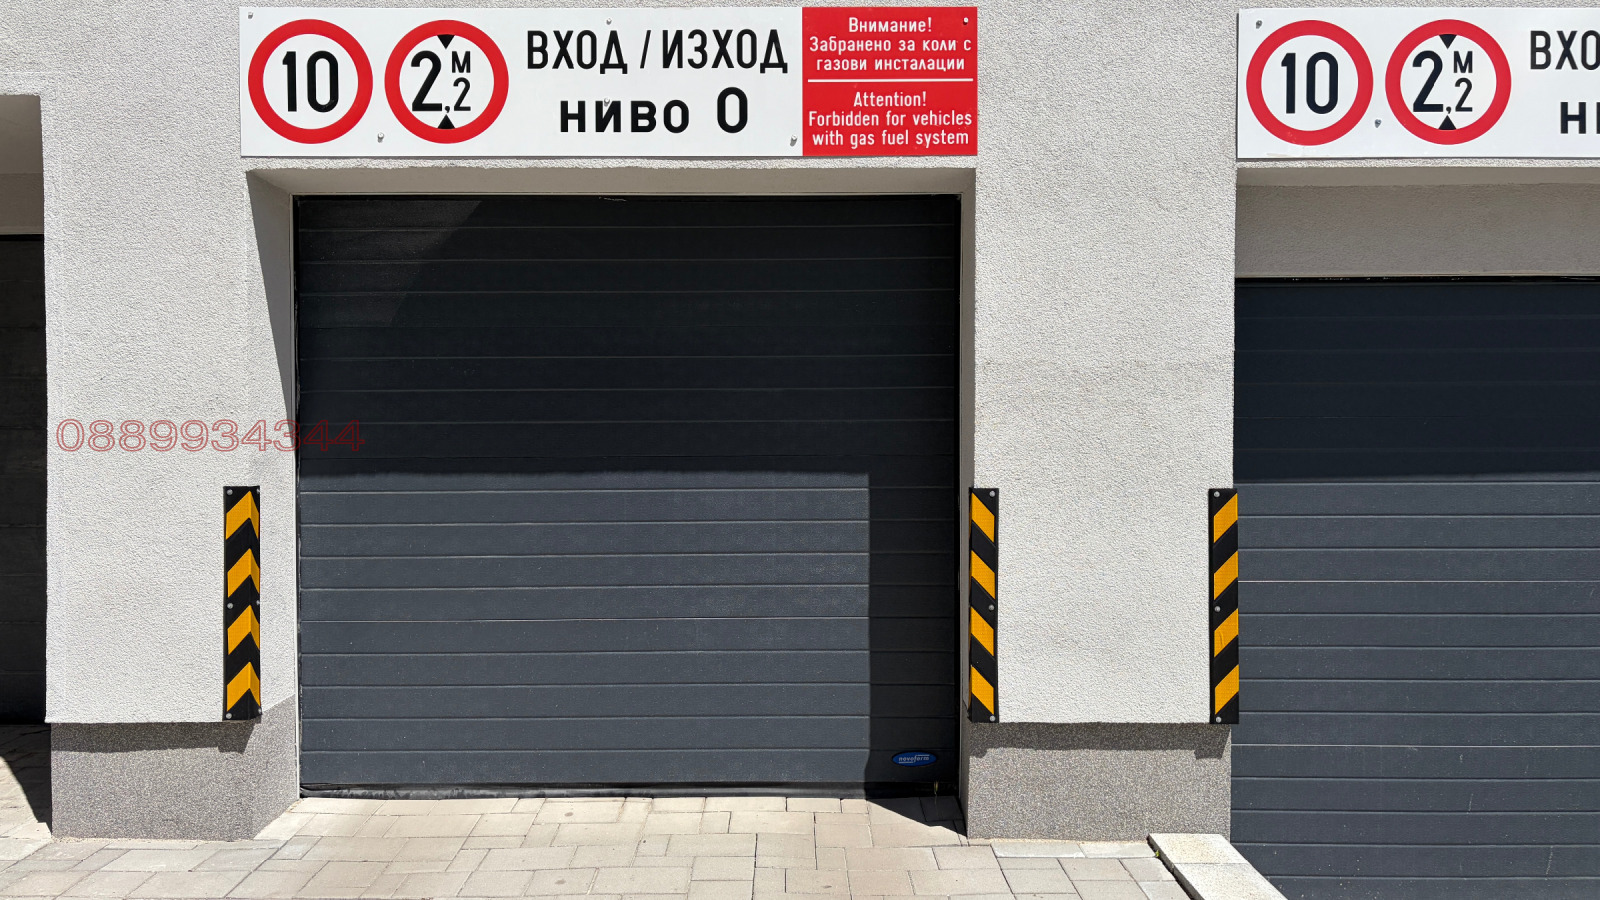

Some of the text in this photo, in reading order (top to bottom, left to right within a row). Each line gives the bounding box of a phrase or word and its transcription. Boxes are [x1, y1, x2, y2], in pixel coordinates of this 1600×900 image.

[849, 17, 932, 33] Внимание!
[527, 30, 628, 75] ВХОД
[662, 28, 788, 74] ИЗХОД
[809, 36, 972, 55] Забранено за коли с
[816, 58, 965, 72] газови инсталации
[282, 50, 339, 113] 10
[1281, 51, 1339, 115] 10
[853, 91, 927, 107] Attention!
[808, 109, 972, 126] Forbidden for vehicles
[812, 129, 969, 149] with gas fuel system
